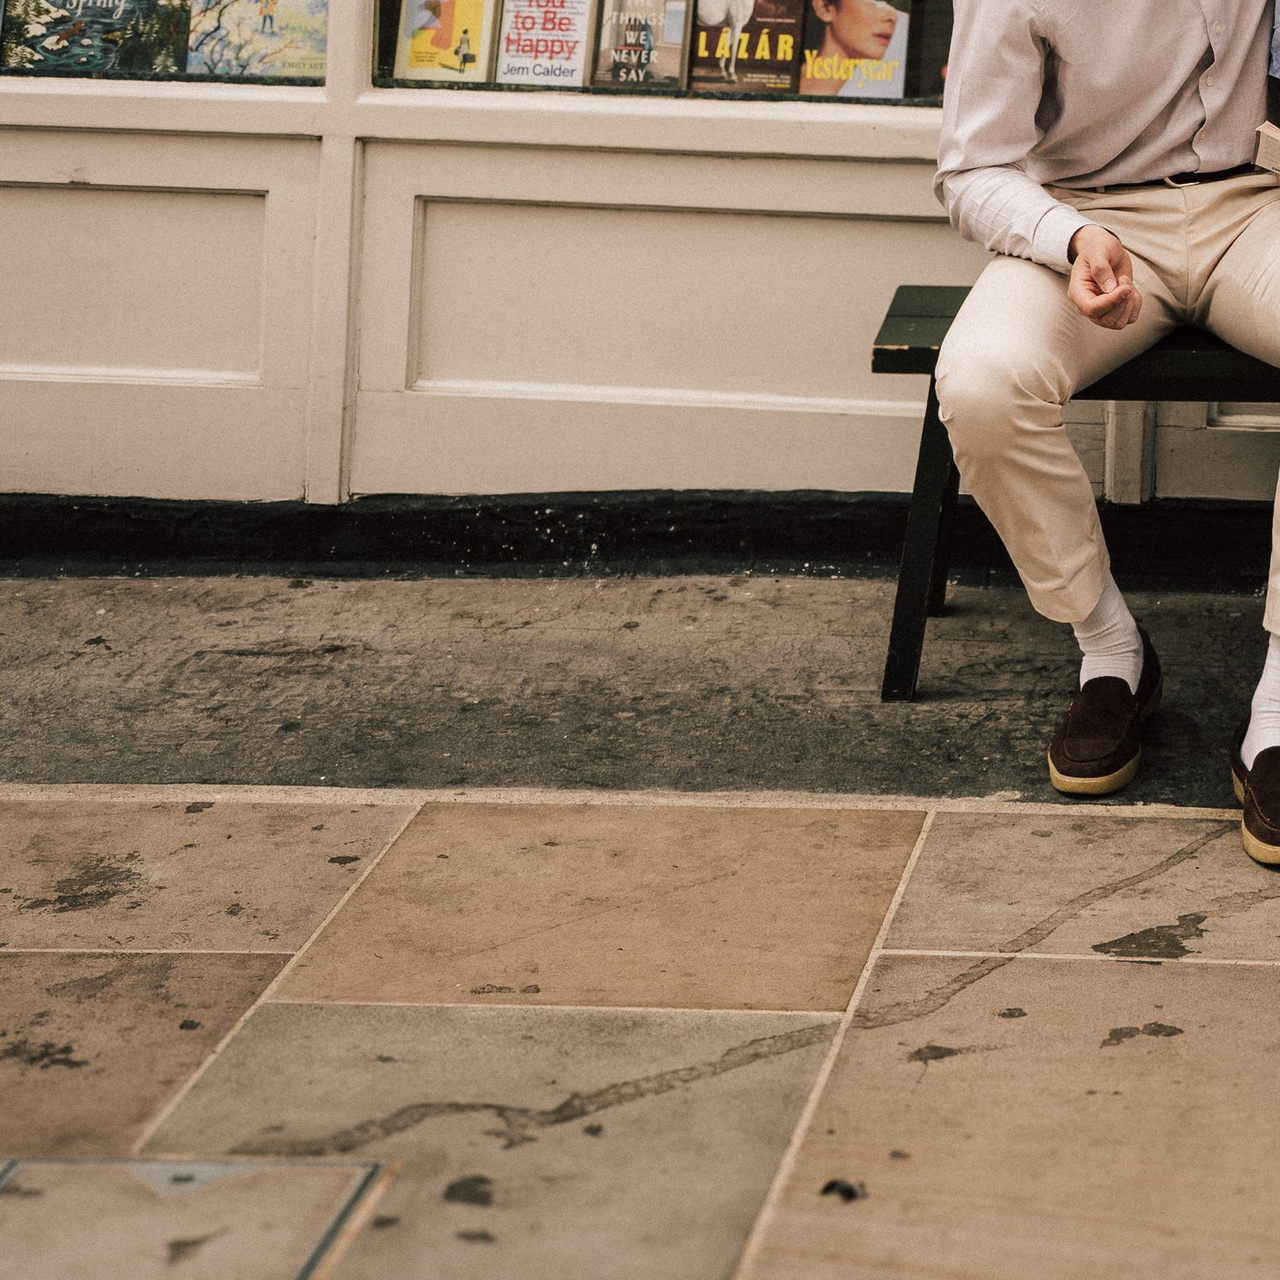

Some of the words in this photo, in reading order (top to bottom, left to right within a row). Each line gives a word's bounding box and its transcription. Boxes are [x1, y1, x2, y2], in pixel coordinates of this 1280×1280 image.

[513, 10, 536, 32] to
[541, 10, 571, 32] Be
[611, 12, 665, 26] THINGS
[625, 31, 648, 45] WE
[697, 27, 794, 62] LÁZÁR
[504, 32, 579, 61] Happy
[610, 49, 658, 64] NEVER
[502, 63, 530, 77] Jem
[532, 63, 578, 78] Calder
[803, 49, 899, 82] Yesteryear
[618, 68, 648, 82] SAY
